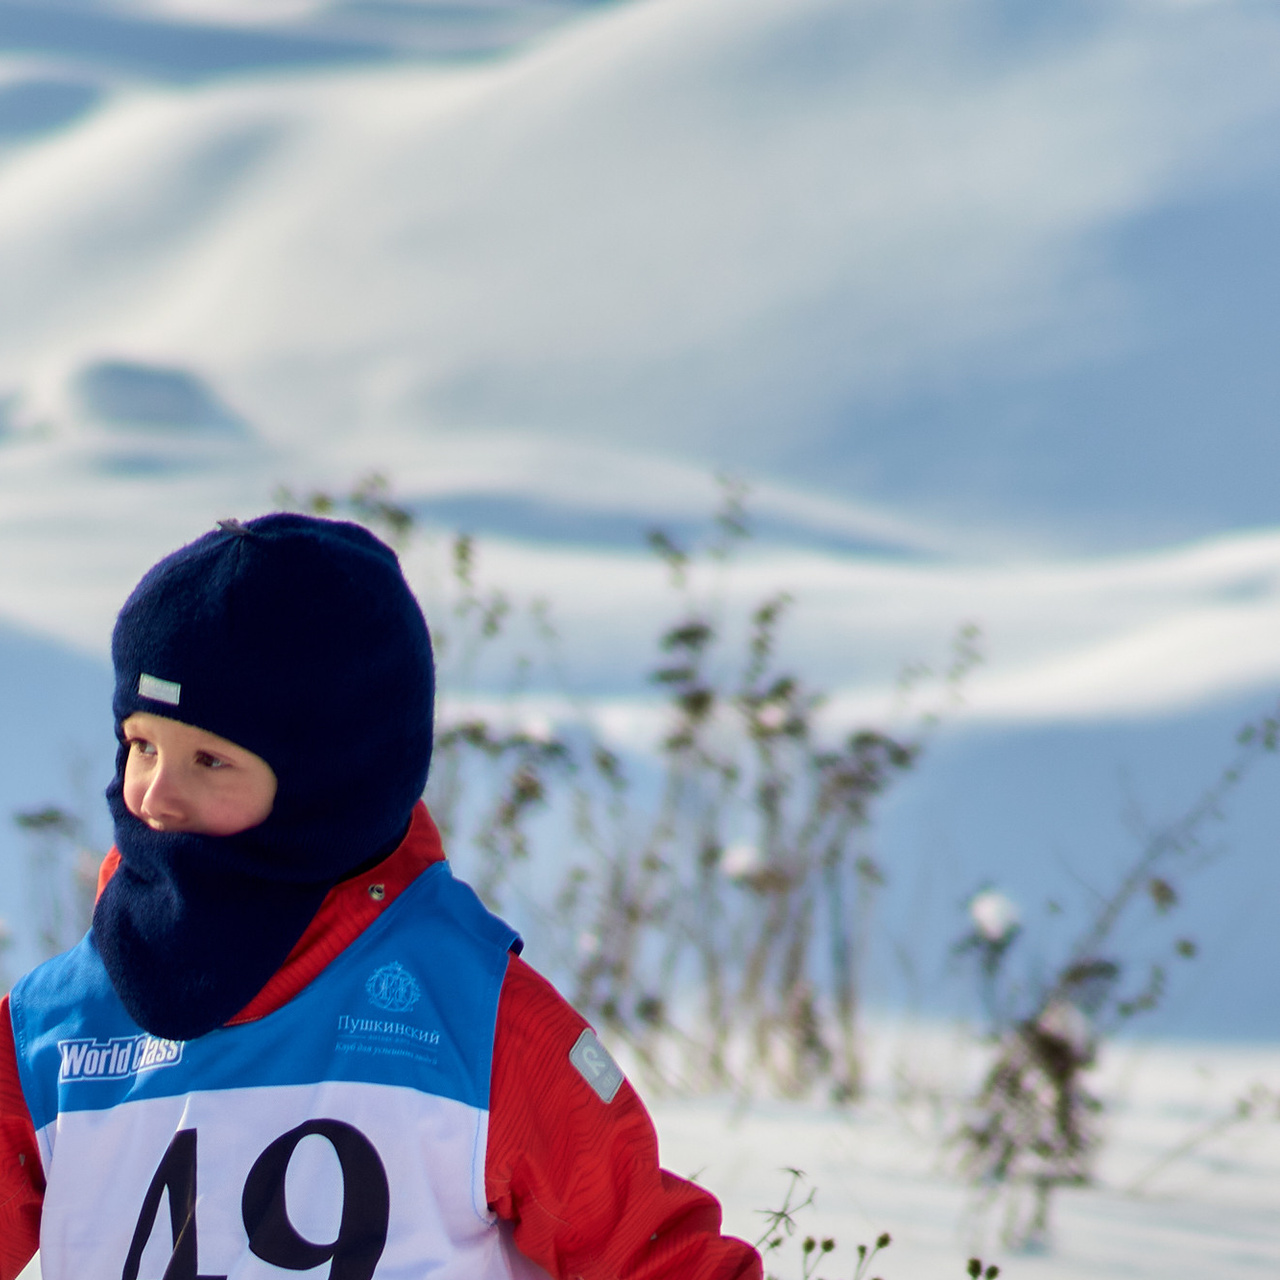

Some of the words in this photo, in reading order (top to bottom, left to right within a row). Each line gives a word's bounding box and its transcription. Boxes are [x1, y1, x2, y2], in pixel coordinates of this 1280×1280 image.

[337, 1014, 440, 1045] Пушкинский
[62, 1042, 133, 1077] World
[131, 1036, 179, 1070] Class
